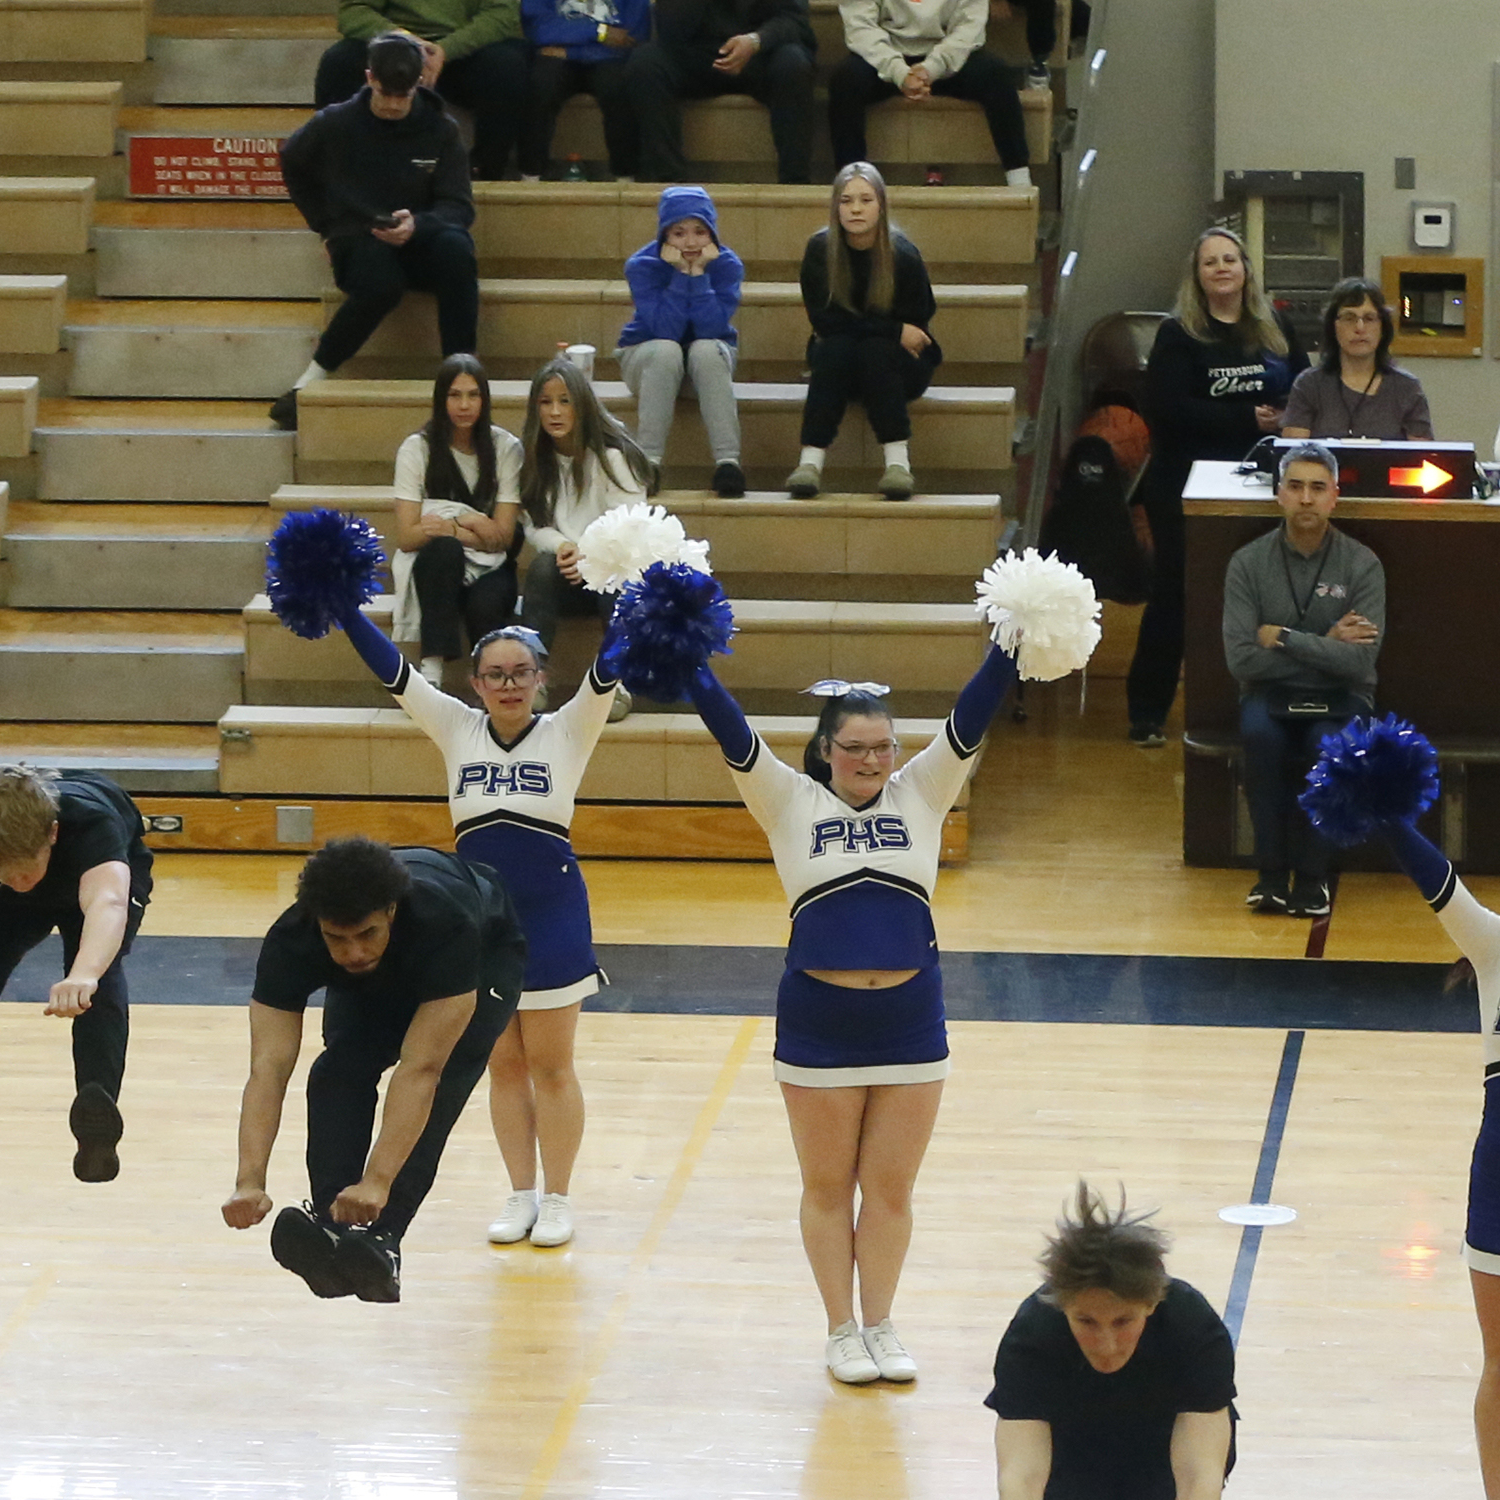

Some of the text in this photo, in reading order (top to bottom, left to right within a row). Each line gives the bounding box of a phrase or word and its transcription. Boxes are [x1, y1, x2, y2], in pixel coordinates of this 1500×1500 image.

[213, 139, 278, 154] CAUTION
[154, 156, 167, 166] DO
[170, 156, 188, 166] NOT
[186, 170, 212, 180] WHEN
[216, 170, 227, 180] IN
[230, 170, 246, 180] THE
[234, 184, 250, 194] THE
[1208, 364, 1266, 378] PETERSBURG
[1210, 376, 1264, 397] Cheer
[454, 761, 553, 799] PHS
[810, 814, 913, 859] PHS
